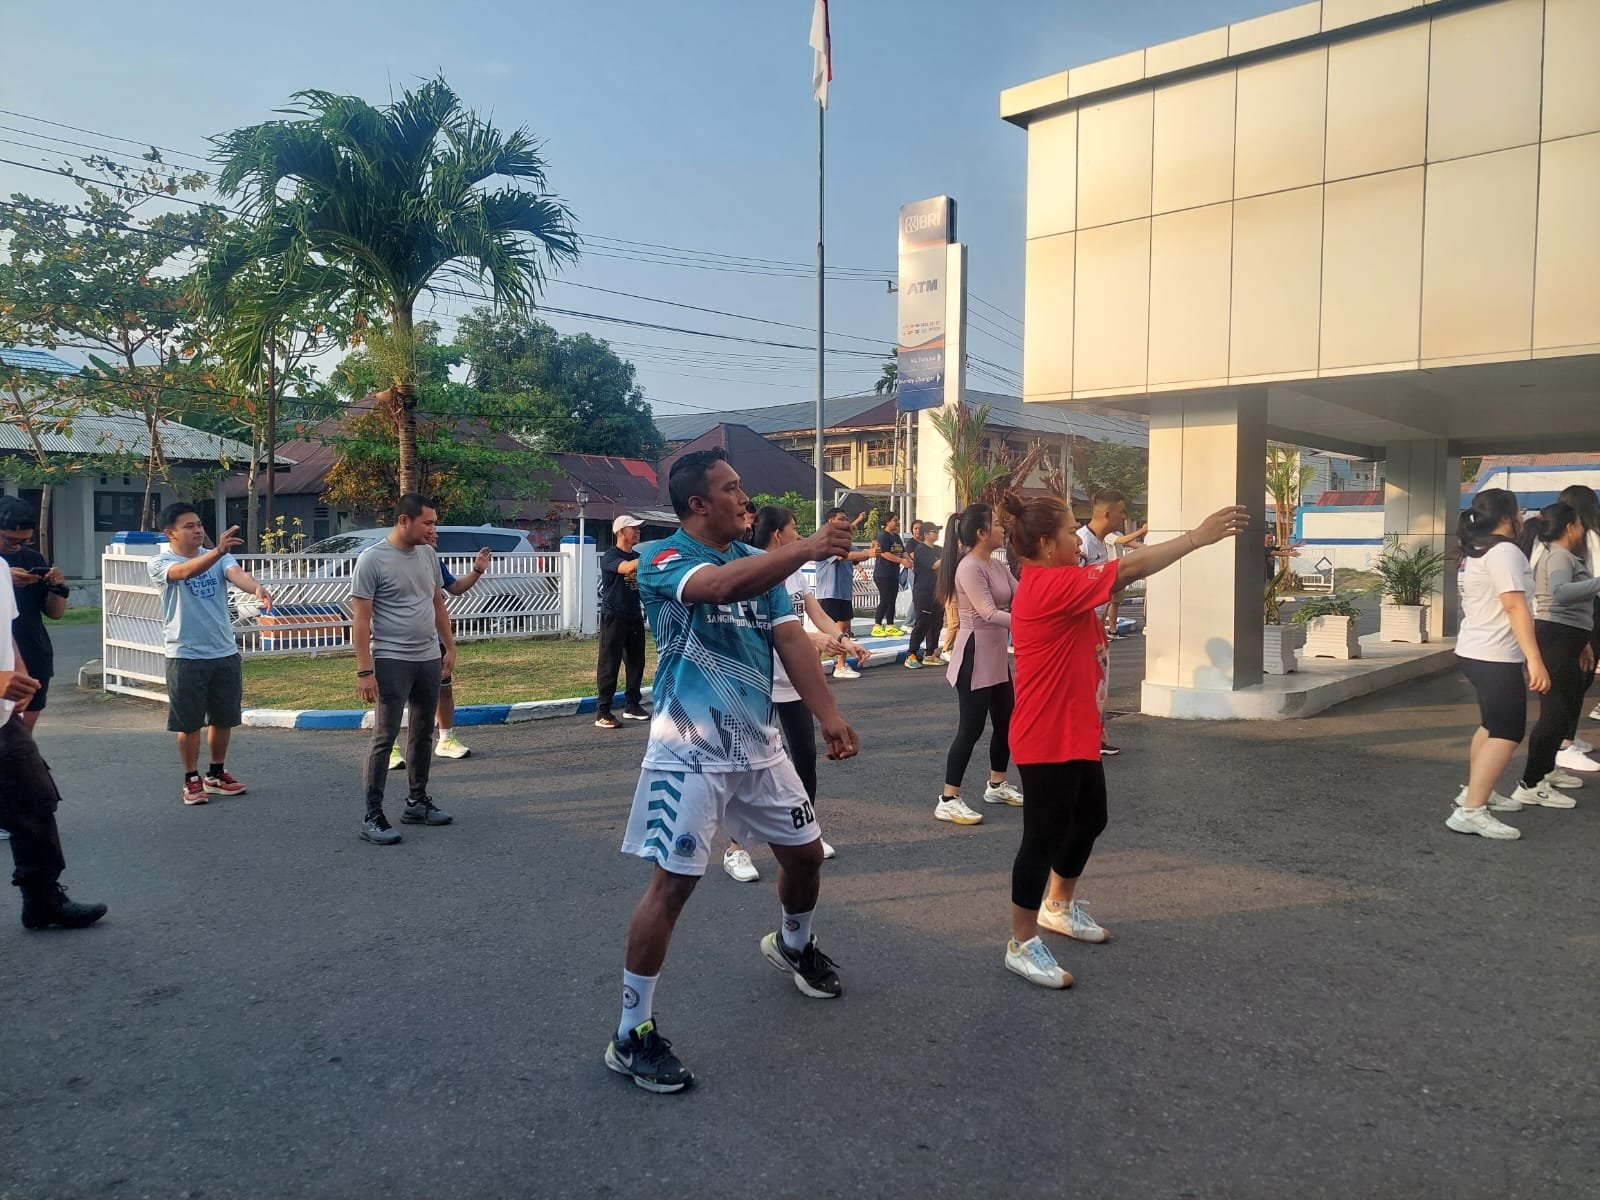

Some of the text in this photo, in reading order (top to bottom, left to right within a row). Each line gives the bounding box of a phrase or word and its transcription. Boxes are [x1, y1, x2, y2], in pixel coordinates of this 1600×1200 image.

[919, 213, 940, 229] BRI
[907, 278, 938, 295] ATM
[706, 613, 736, 624] SANGIH
[790, 800, 815, 830] 80
